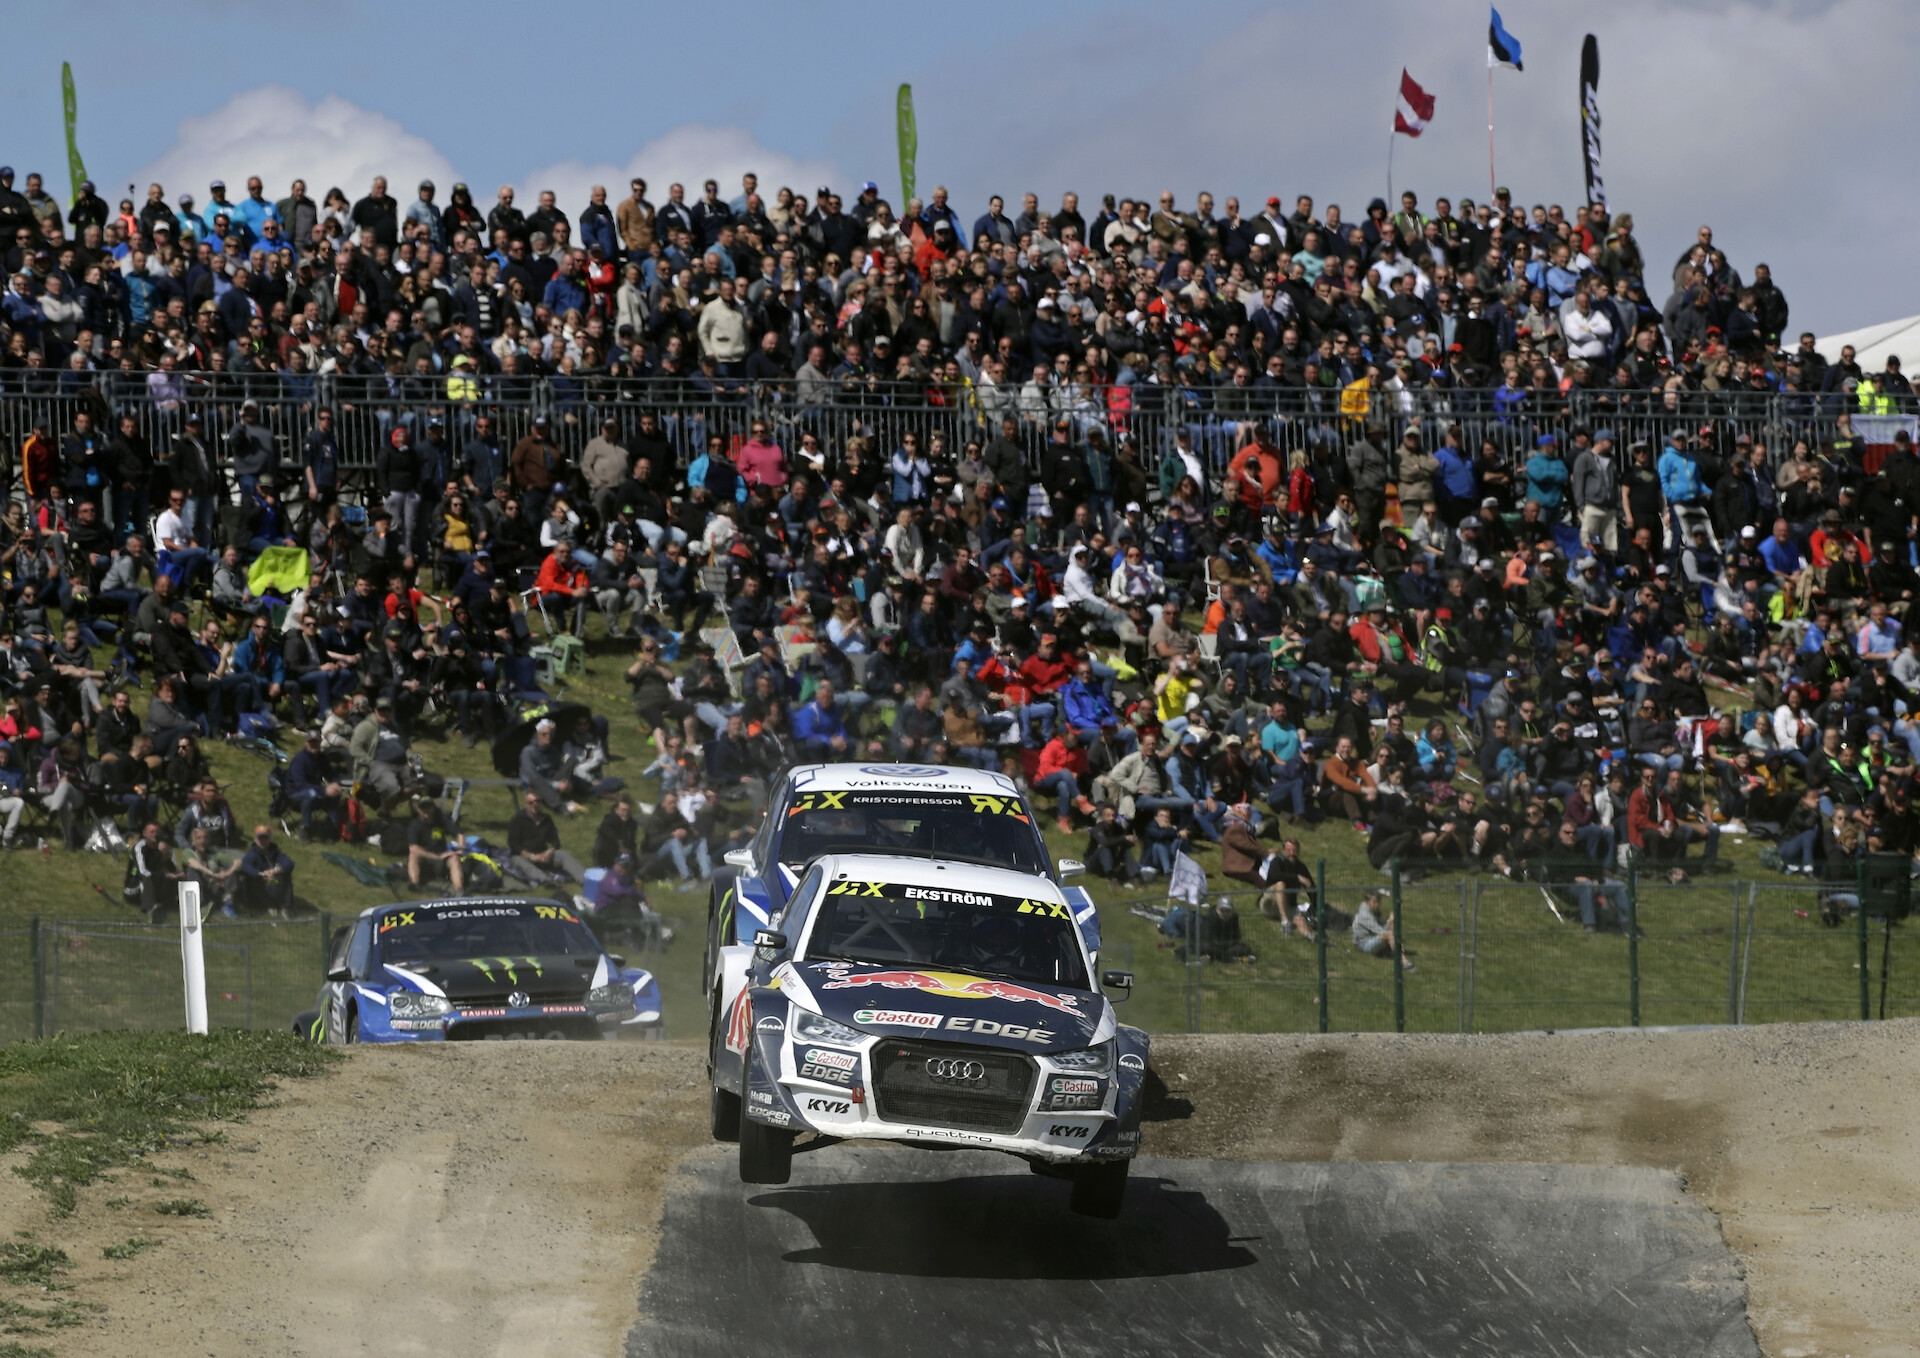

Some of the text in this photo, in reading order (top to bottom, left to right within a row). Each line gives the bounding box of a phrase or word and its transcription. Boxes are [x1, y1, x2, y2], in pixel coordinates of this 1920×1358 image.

[846, 779, 972, 791] Volkswagen
[853, 796, 963, 806] KRISTOFFERSSON
[905, 887, 993, 907] EKSTRÖM
[437, 908, 521, 920] SOLBERG
[462, 1009, 506, 1017] BAUHAUS
[543, 1005, 586, 1013] BAUHAUS
[411, 1020, 444, 1030] EDGE
[875, 1011, 1057, 1044] Castrol EDGE
[816, 1052, 854, 1068] Castrol
[1120, 1061, 1142, 1069] MAN
[800, 1063, 854, 1084] EDGE
[1064, 1081, 1096, 1092] Castrol
[807, 1099, 850, 1114] KYB
[1051, 1095, 1099, 1108] EDGE
[748, 1105, 791, 1121] COOPER
[906, 1128, 992, 1143] quattro
[1049, 1125, 1089, 1138] KYB
